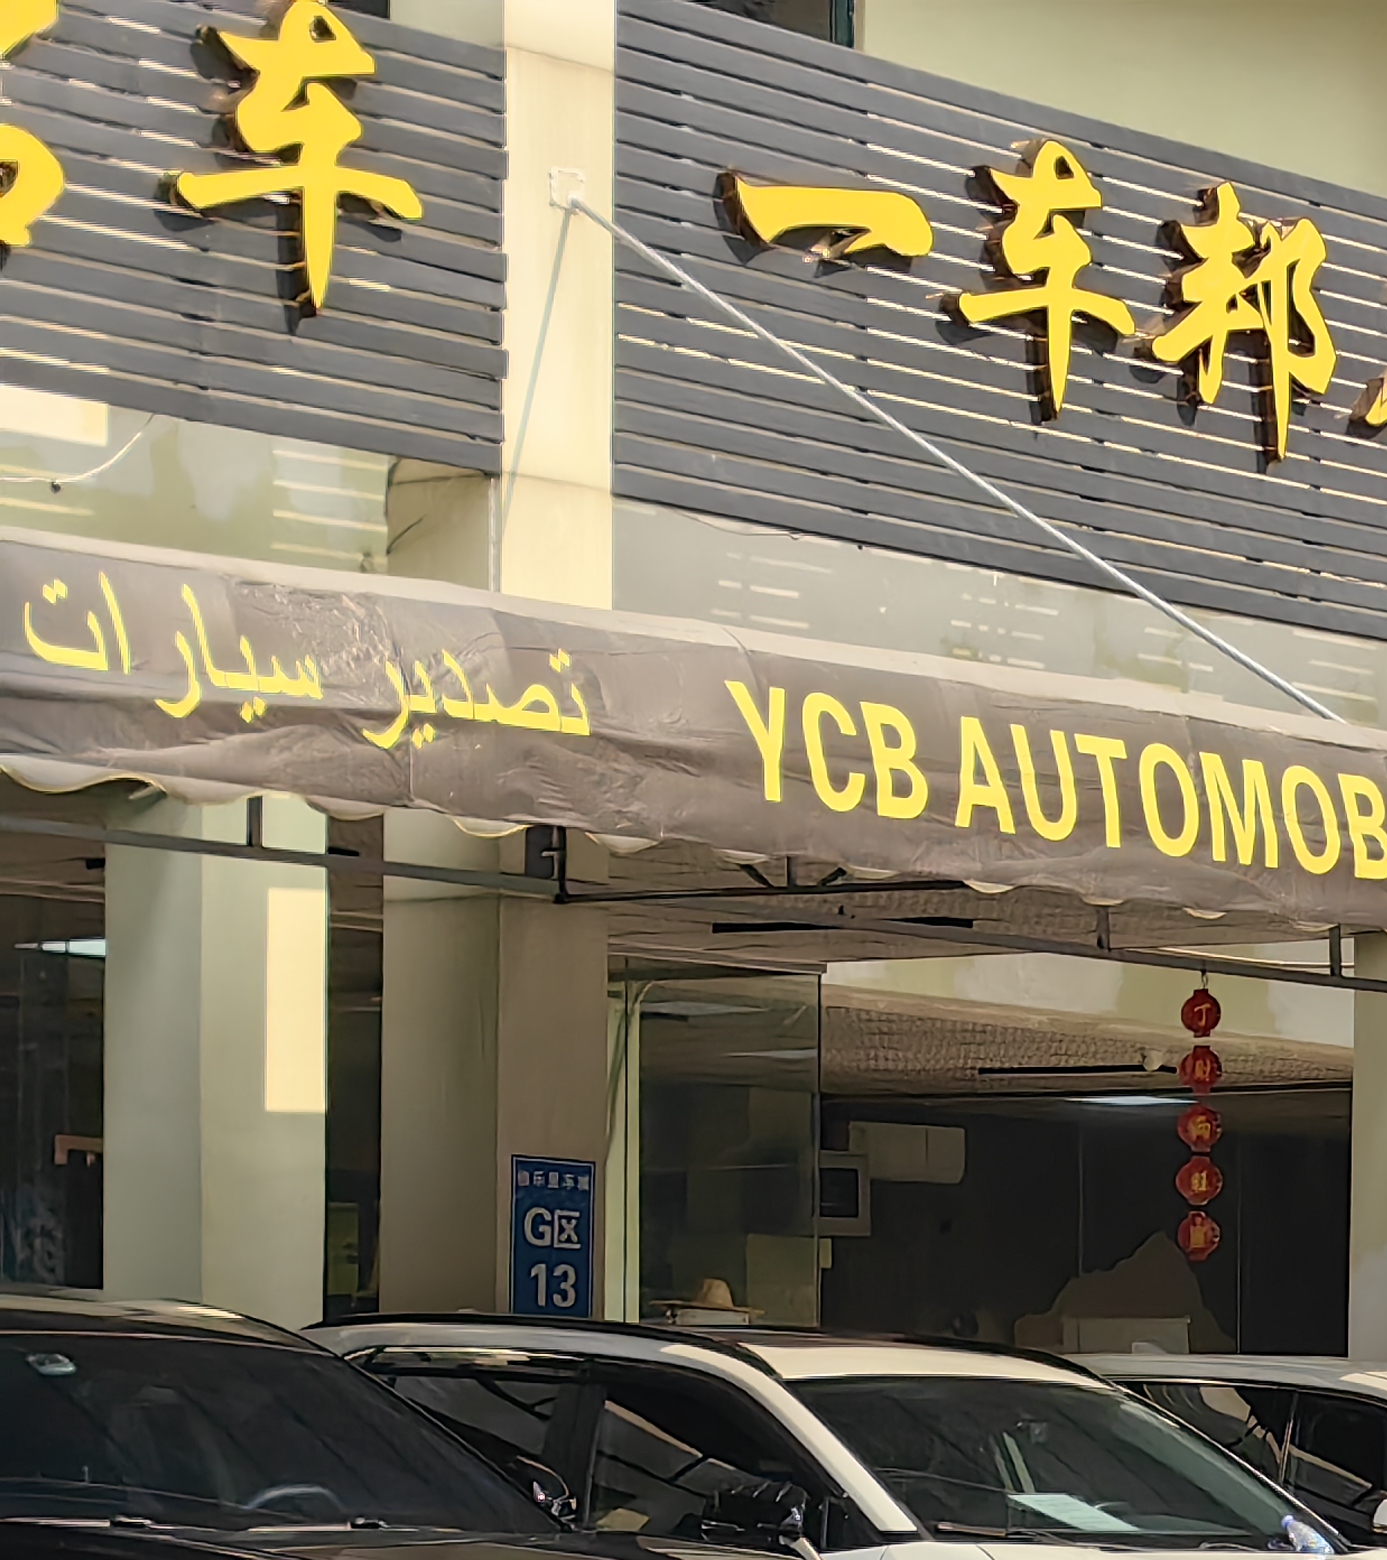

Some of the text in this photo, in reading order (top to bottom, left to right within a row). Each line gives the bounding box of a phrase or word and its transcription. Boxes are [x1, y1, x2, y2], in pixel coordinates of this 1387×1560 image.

[362, 648, 591, 749] تصدير
[724, 680, 929, 820] YCB
[523, 1206, 582, 1250] G区
[529, 1263, 577, 1309] 13
